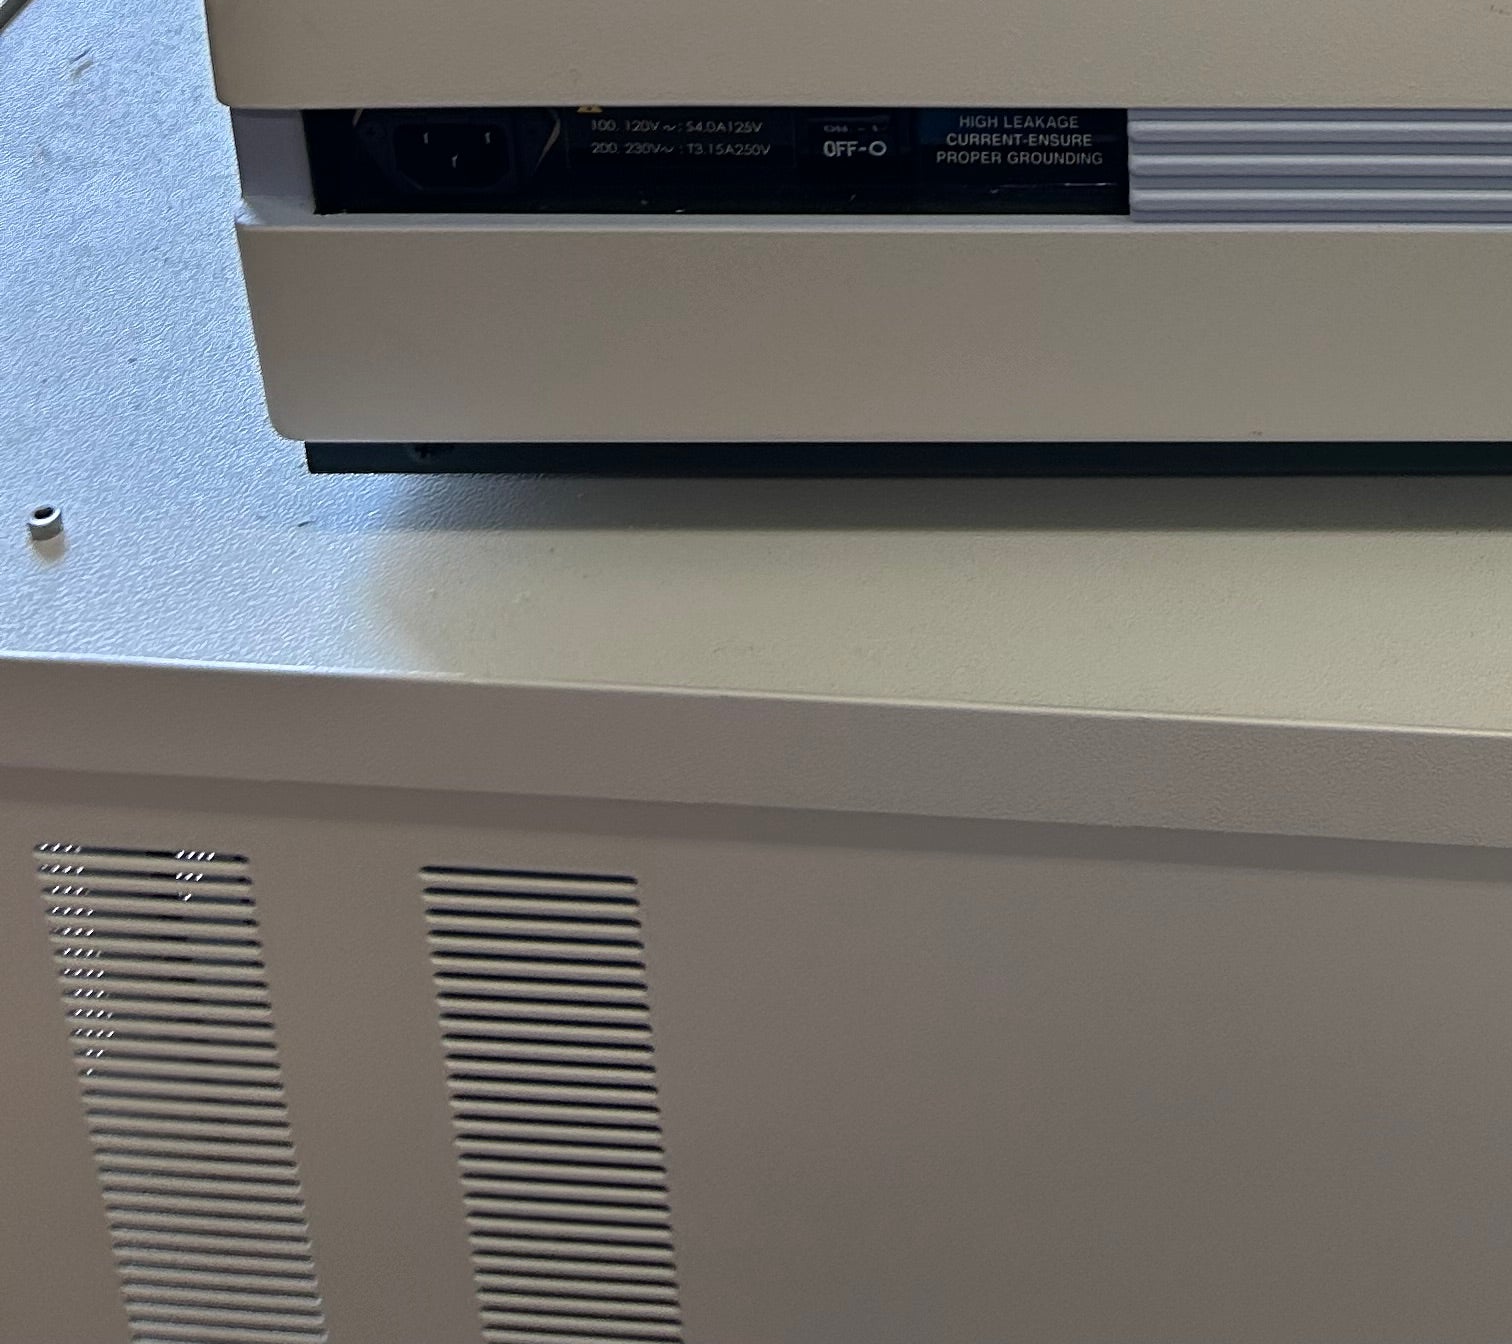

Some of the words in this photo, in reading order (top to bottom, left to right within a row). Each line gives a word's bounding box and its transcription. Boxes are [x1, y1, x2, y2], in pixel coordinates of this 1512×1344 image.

[959, 115, 998, 128] HIGH
[1004, 115, 1079, 128] LEAKAGE
[946, 133, 1092, 147] CURRENT-ENSURE
[936, 151, 1002, 165] PROPER
[1007, 151, 1103, 165] GROUNDING
